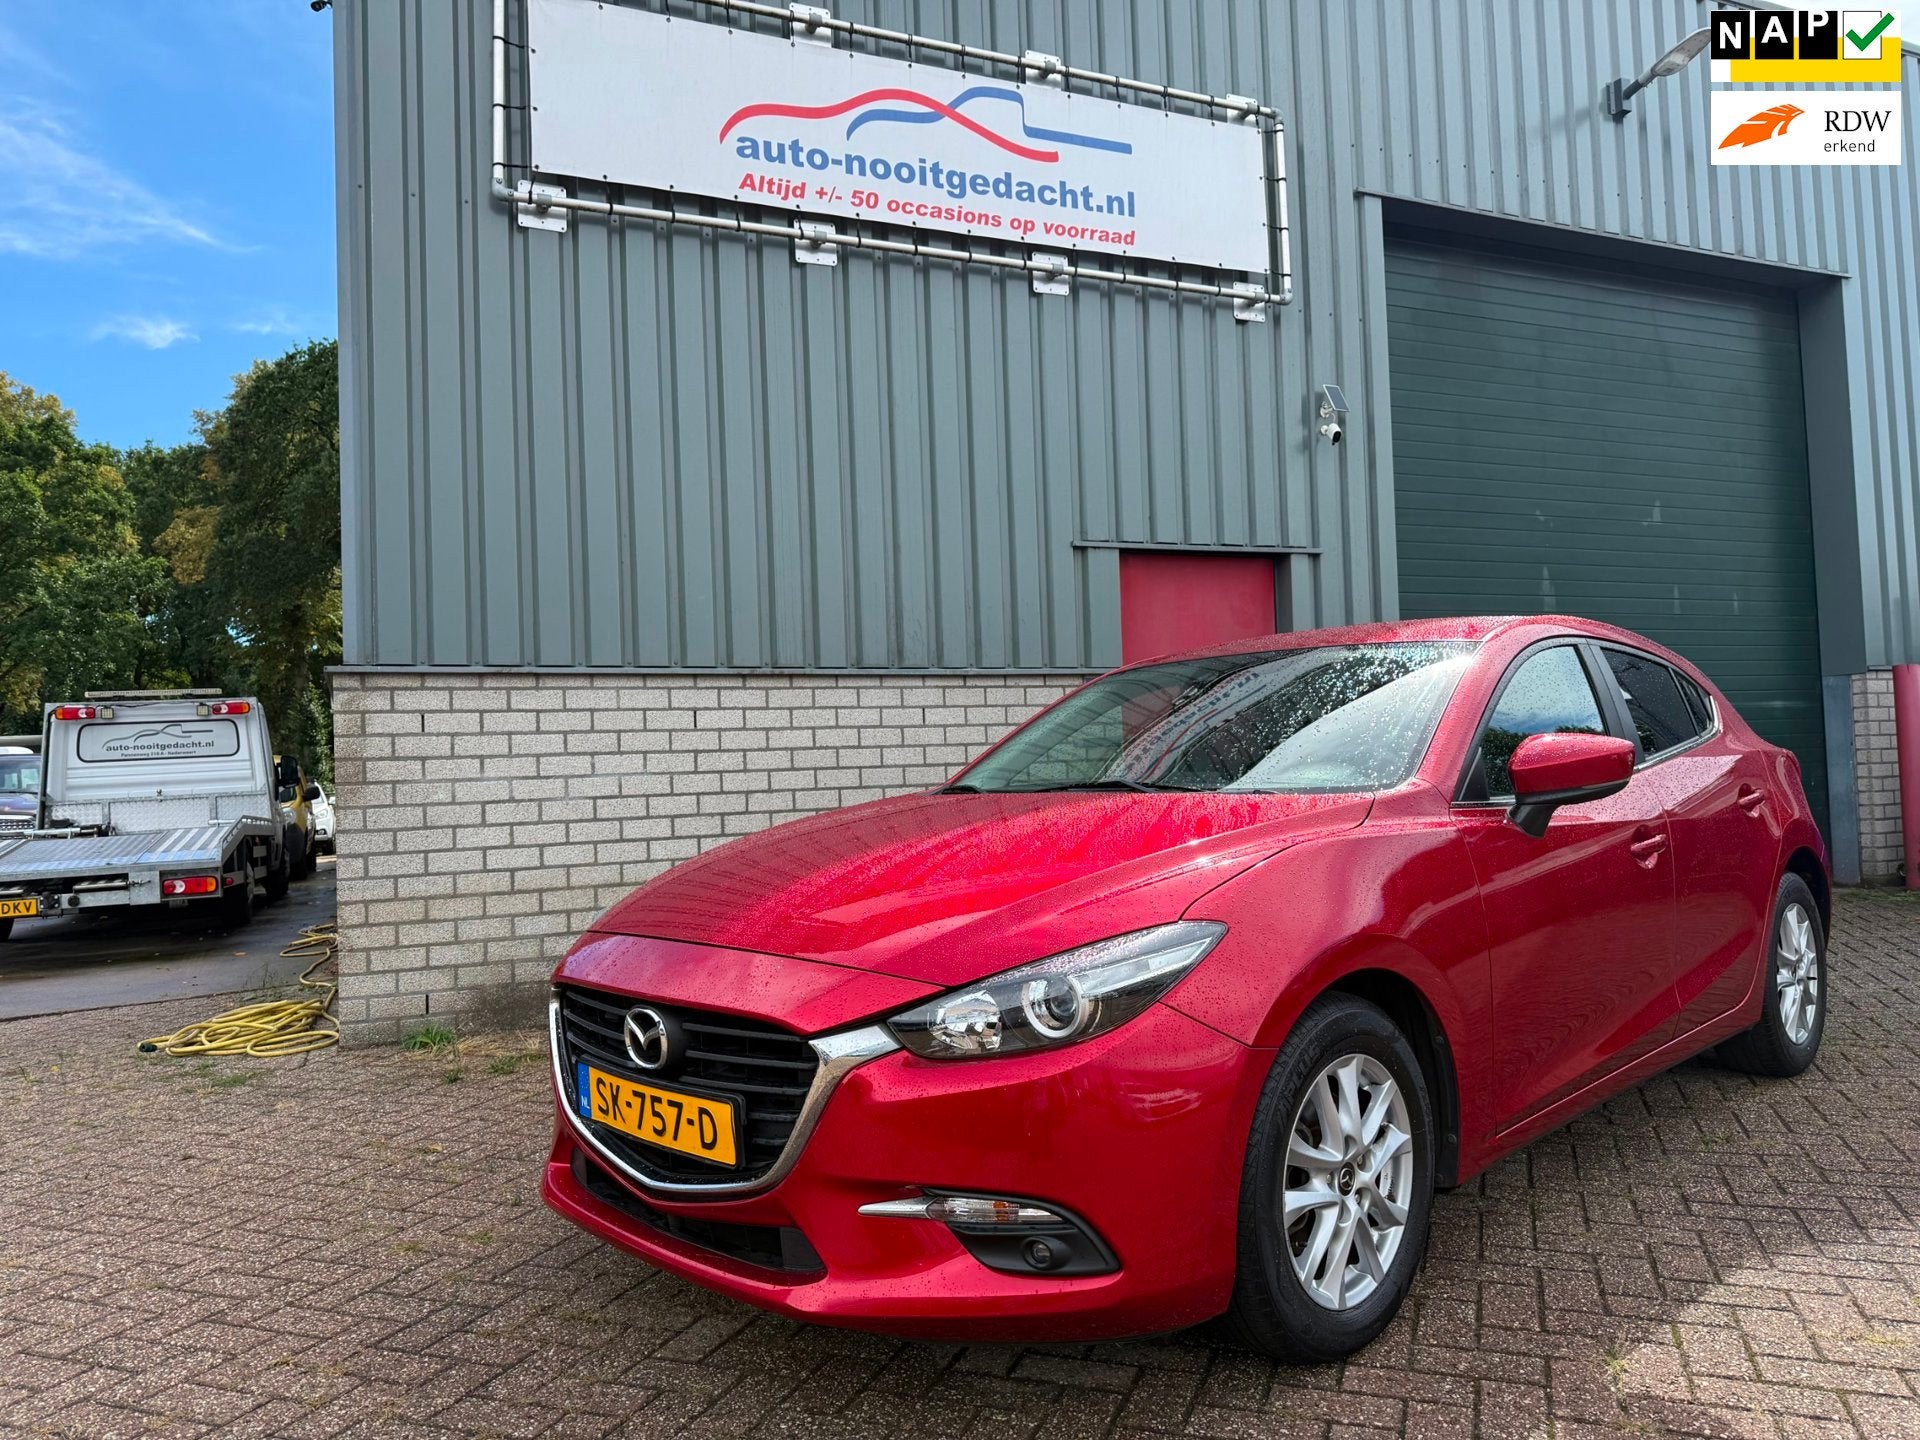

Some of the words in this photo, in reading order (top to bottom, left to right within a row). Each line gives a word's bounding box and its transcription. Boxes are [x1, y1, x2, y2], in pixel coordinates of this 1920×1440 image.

[735, 136, 1136, 218] auto-nooitgedacht.nl
[738, 172, 807, 201] Altijd
[815, 186, 843, 204] +/-
[850, 189, 880, 209] 50
[886, 198, 1002, 228] occasions
[1009, 216, 1036, 235] op
[1043, 221, 1136, 246] voorraad
[105, 741, 214, 751] auto-nooitgedacht.nl
[1, 901, 32, 915] DKV
[581, 1095, 590, 1110] NL
[596, 1076, 718, 1150] SK-757-D
